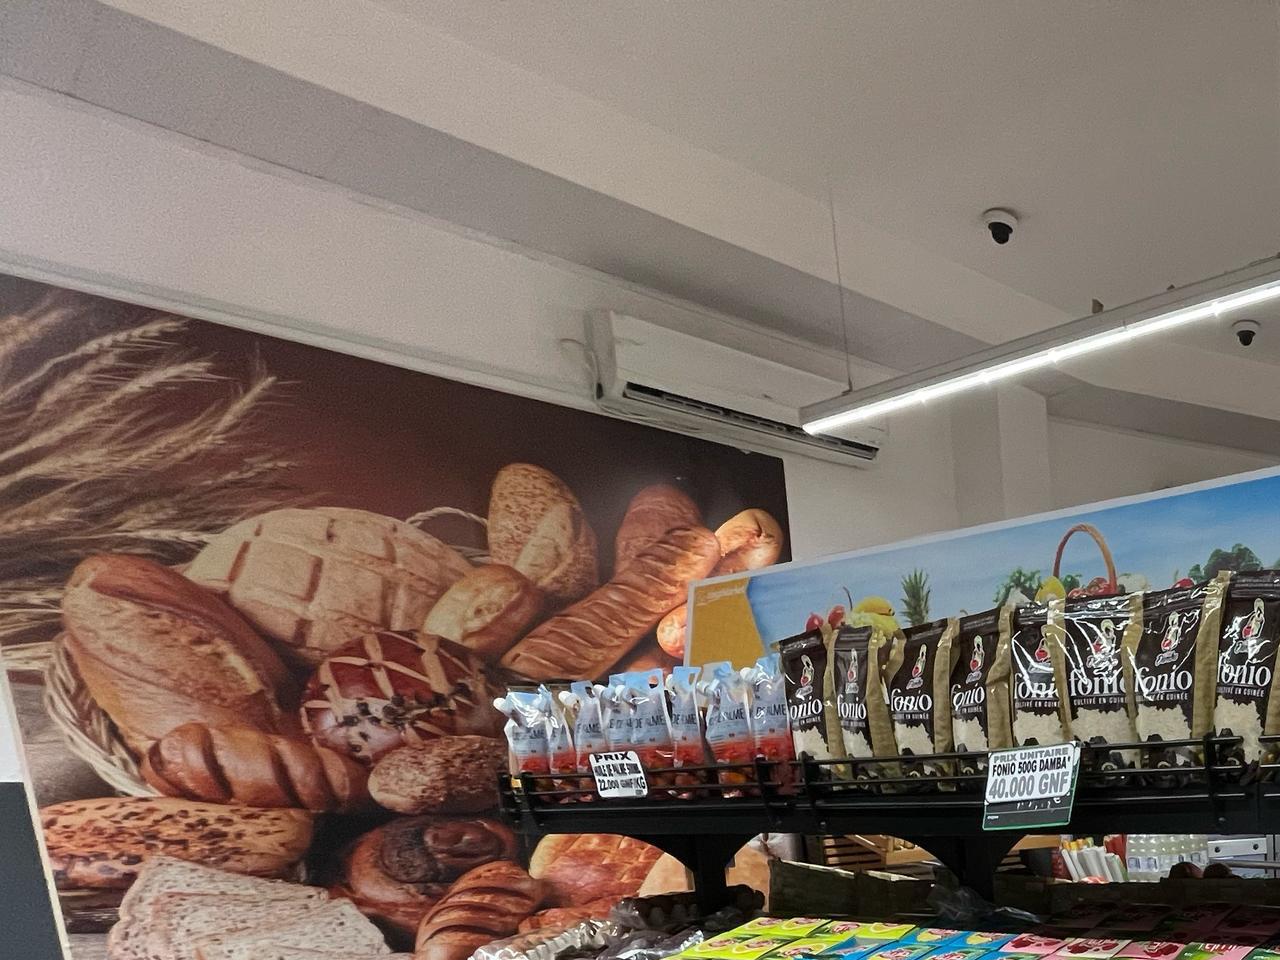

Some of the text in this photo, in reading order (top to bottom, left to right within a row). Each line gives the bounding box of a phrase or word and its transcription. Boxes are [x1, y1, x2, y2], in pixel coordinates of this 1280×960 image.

[951, 683, 985, 712] fonio
[1015, 673, 1059, 699] foni
[790, 699, 822, 720] onio
[837, 695, 866, 720] fonio
[891, 688, 932, 711] fonio
[594, 751, 631, 763] PRIX
[994, 747, 1069, 763] PRIX UNITAIRE
[992, 763, 1016, 777] FONIO
[1018, 760, 1037, 773] 500G
[989, 771, 1069, 798] 40.000 GNF
